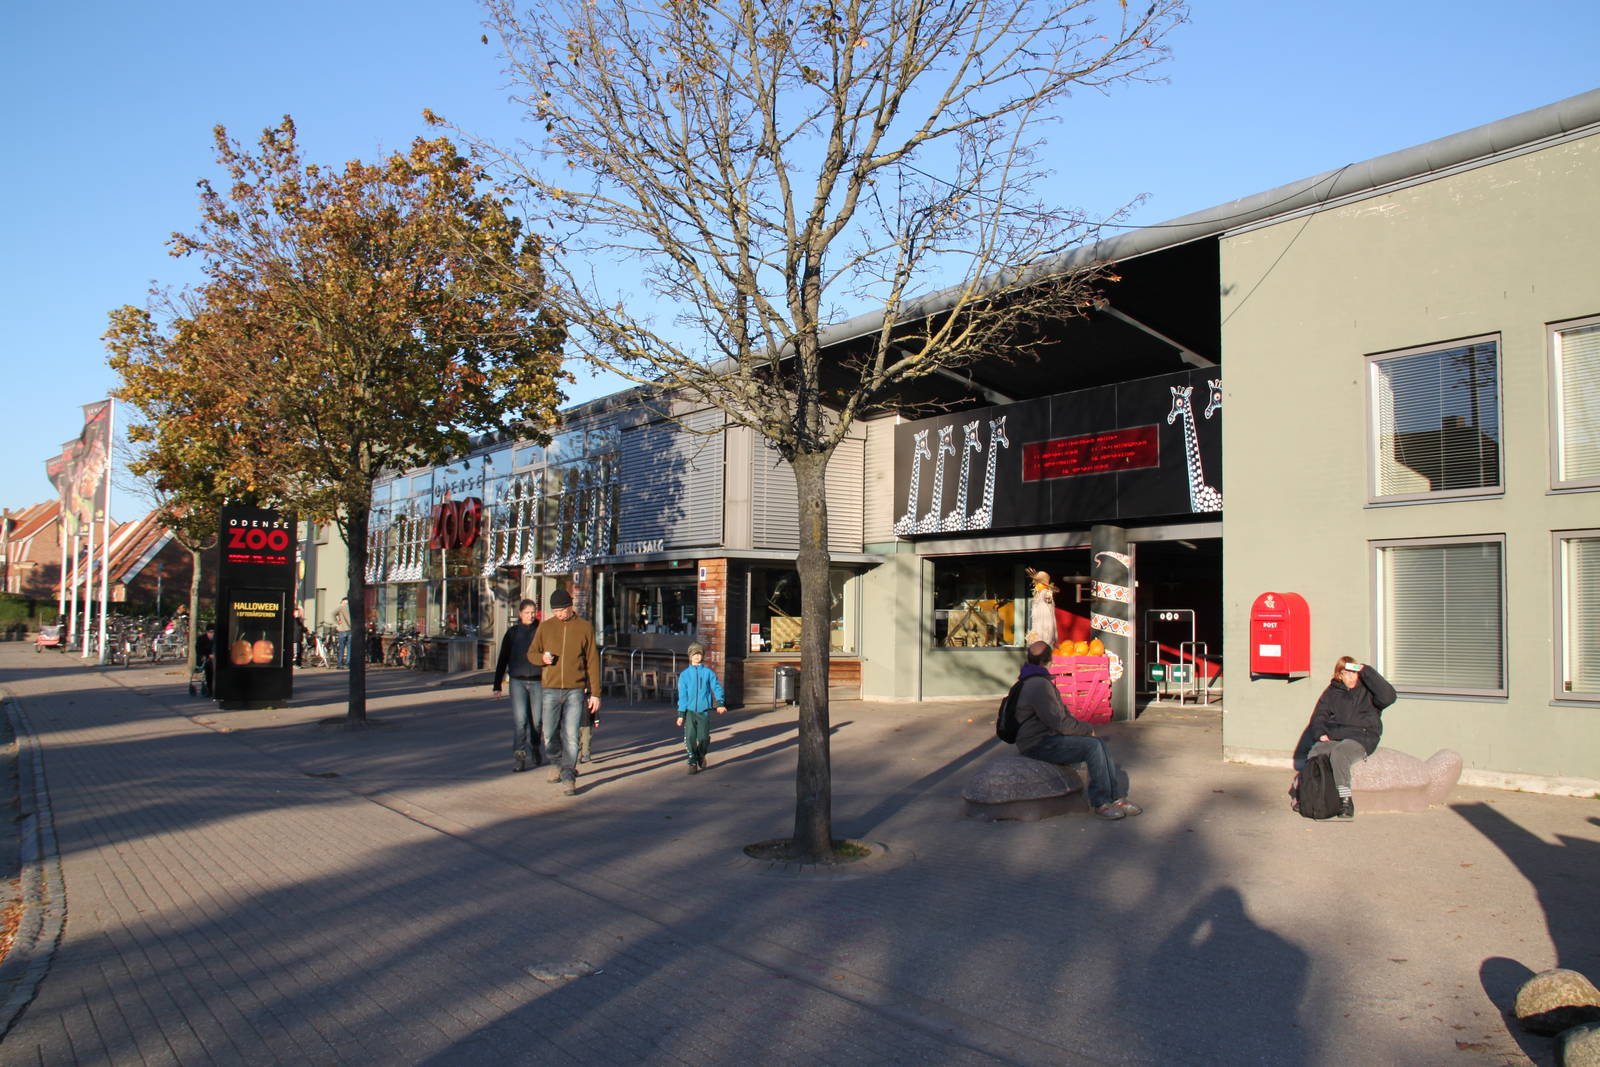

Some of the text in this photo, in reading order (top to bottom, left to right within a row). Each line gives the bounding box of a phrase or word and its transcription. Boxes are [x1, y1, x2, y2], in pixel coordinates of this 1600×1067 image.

[230, 518, 289, 529] ODENSE
[430, 496, 483, 550] ZOO
[228, 528, 289, 551] ZOO
[233, 602, 279, 611] HALLOWEEN
